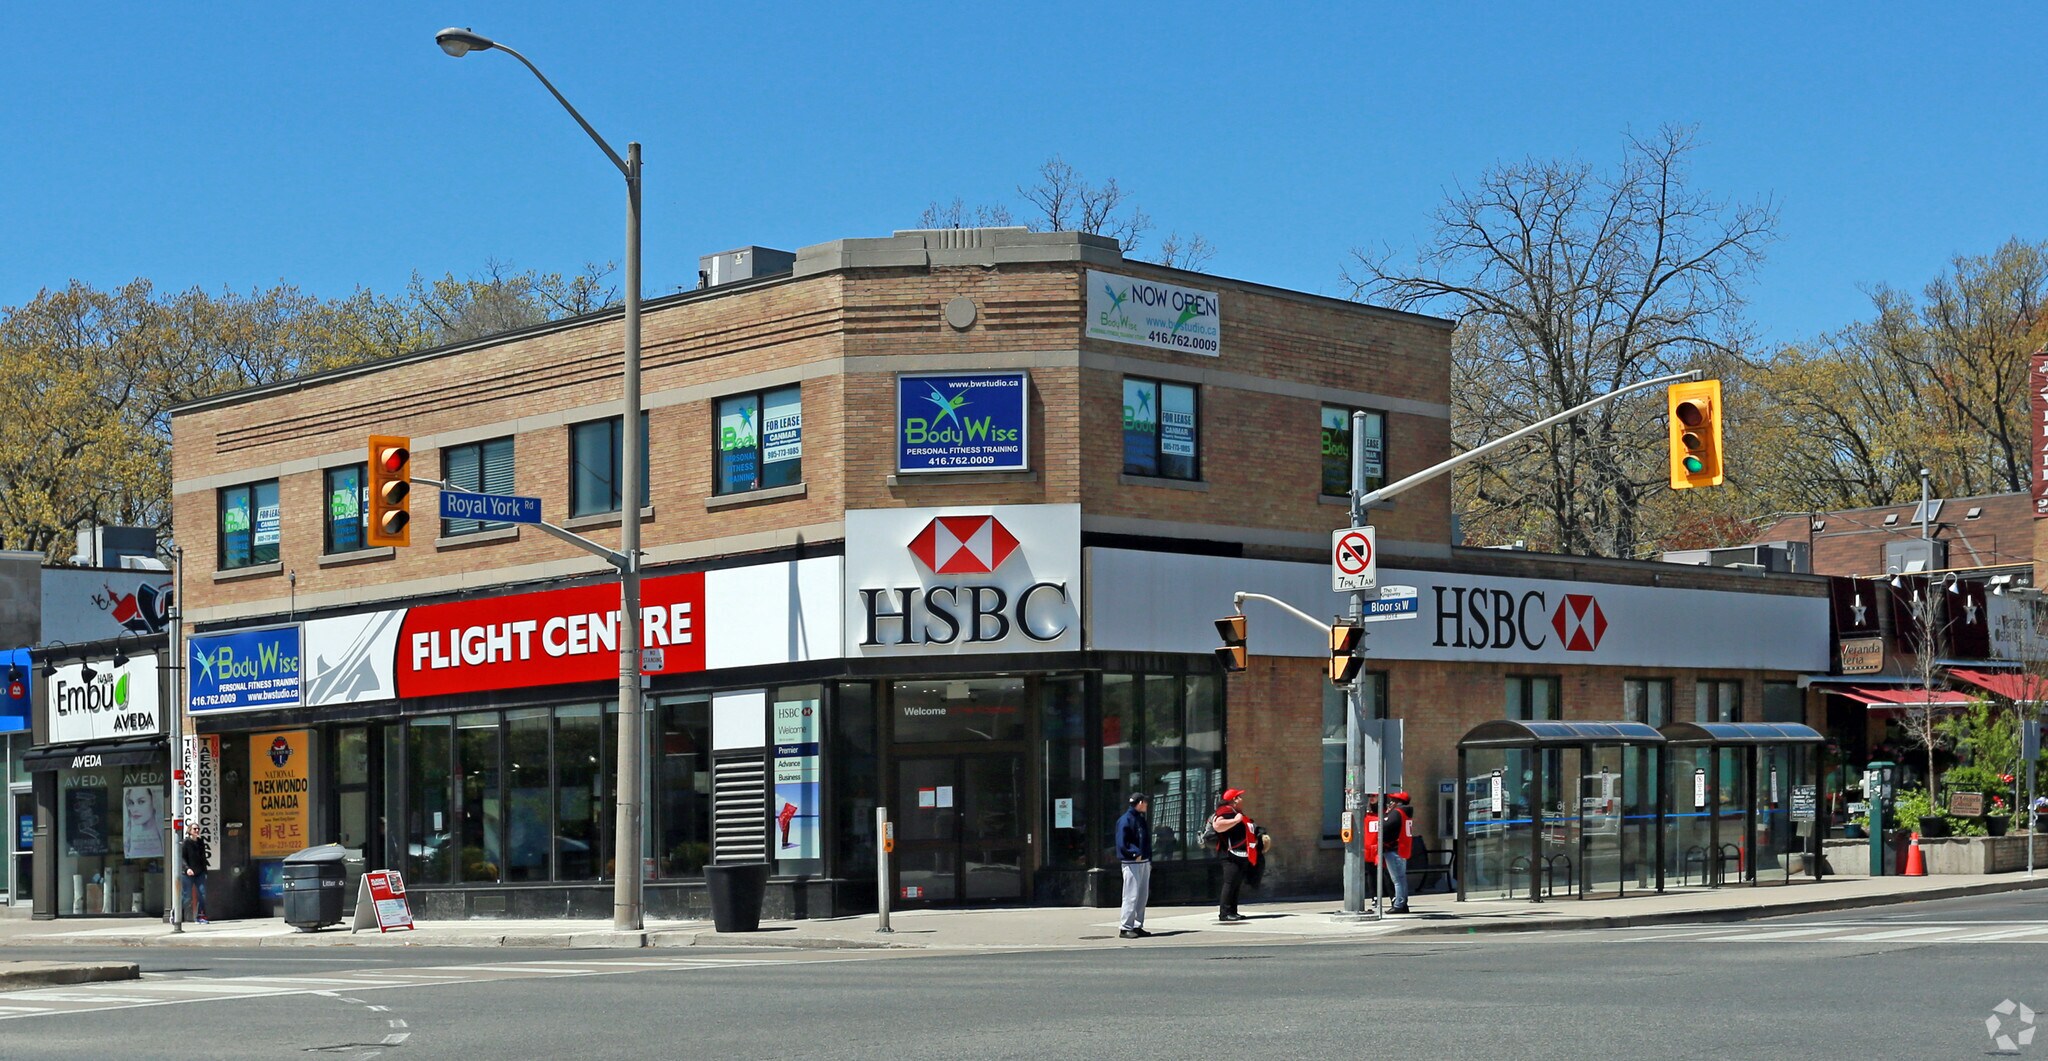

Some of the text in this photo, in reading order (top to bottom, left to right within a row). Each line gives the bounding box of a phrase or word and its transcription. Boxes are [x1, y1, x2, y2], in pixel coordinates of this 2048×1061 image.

[1132, 284, 1217, 317] NOW OPEN
[1148, 330, 1217, 351] 416.762.0009
[949, 379, 1019, 389] www.bwstudio.ca
[766, 415, 800, 432] FOR LEASE
[1162, 412, 1192, 426] FOR LEASE
[769, 430, 797, 442] CANMAR
[907, 445, 1018, 455] PERSONAL FITNESS TRAINING
[928, 456, 995, 465] 416.762.0009
[448, 493, 534, 517] Royal York Rd
[1371, 600, 1409, 613] Bloor St W
[859, 581, 1068, 647] HSBC
[1432, 585, 1546, 651] HSBC
[411, 602, 692, 672] FLIGHT CENRE
[219, 677, 299, 692] PERSONAL FITNESS TRAINING
[57, 680, 114, 714] Embu
[191, 689, 299, 707] 416.762.0009 www.bwstudio.ca
[778, 707, 800, 719] HSBC
[904, 706, 946, 716] Welcome
[113, 711, 155, 732] AVEDA
[778, 725, 807, 735] Welcome
[778, 746, 799, 755] Premier
[72, 755, 102, 768] AVEDA
[778, 759, 801, 768] Advance
[123, 772, 164, 785] AVEDA
[200, 738, 212, 814] TAEKWONDO
[264, 769, 296, 779] NATIONAL
[778, 773, 801, 781] Business
[64, 775, 107, 788] AVEDA
[253, 778, 308, 795] TAEKWONDO
[261, 795, 299, 810] CANADA
